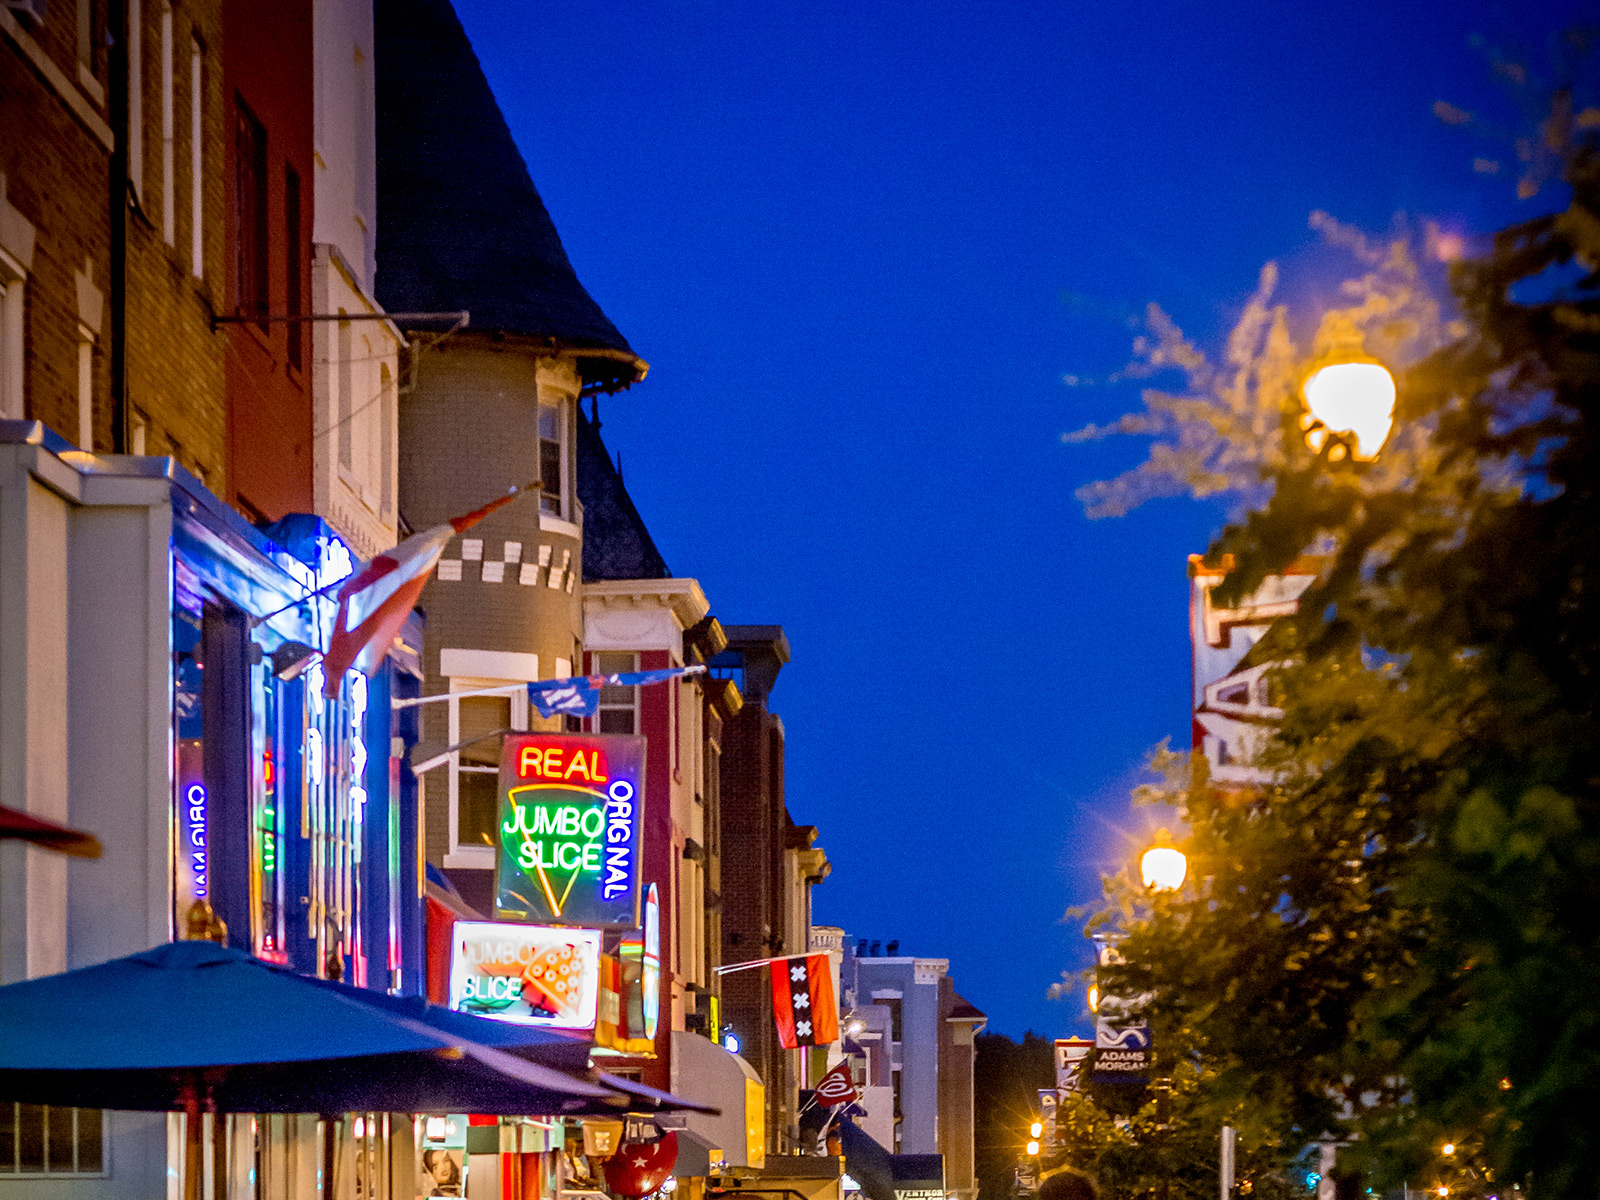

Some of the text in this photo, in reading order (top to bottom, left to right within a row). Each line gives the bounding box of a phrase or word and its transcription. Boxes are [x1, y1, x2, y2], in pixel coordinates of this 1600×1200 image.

[520, 747, 608, 782] REAL
[503, 806, 606, 838] JUMBO
[518, 842, 602, 871] SLICE
[464, 941, 533, 966] UMBO
[461, 974, 522, 1001] SLICE
[1094, 1061, 1149, 1071] MORGAN
[1100, 1051, 1145, 1061] ADAMS
